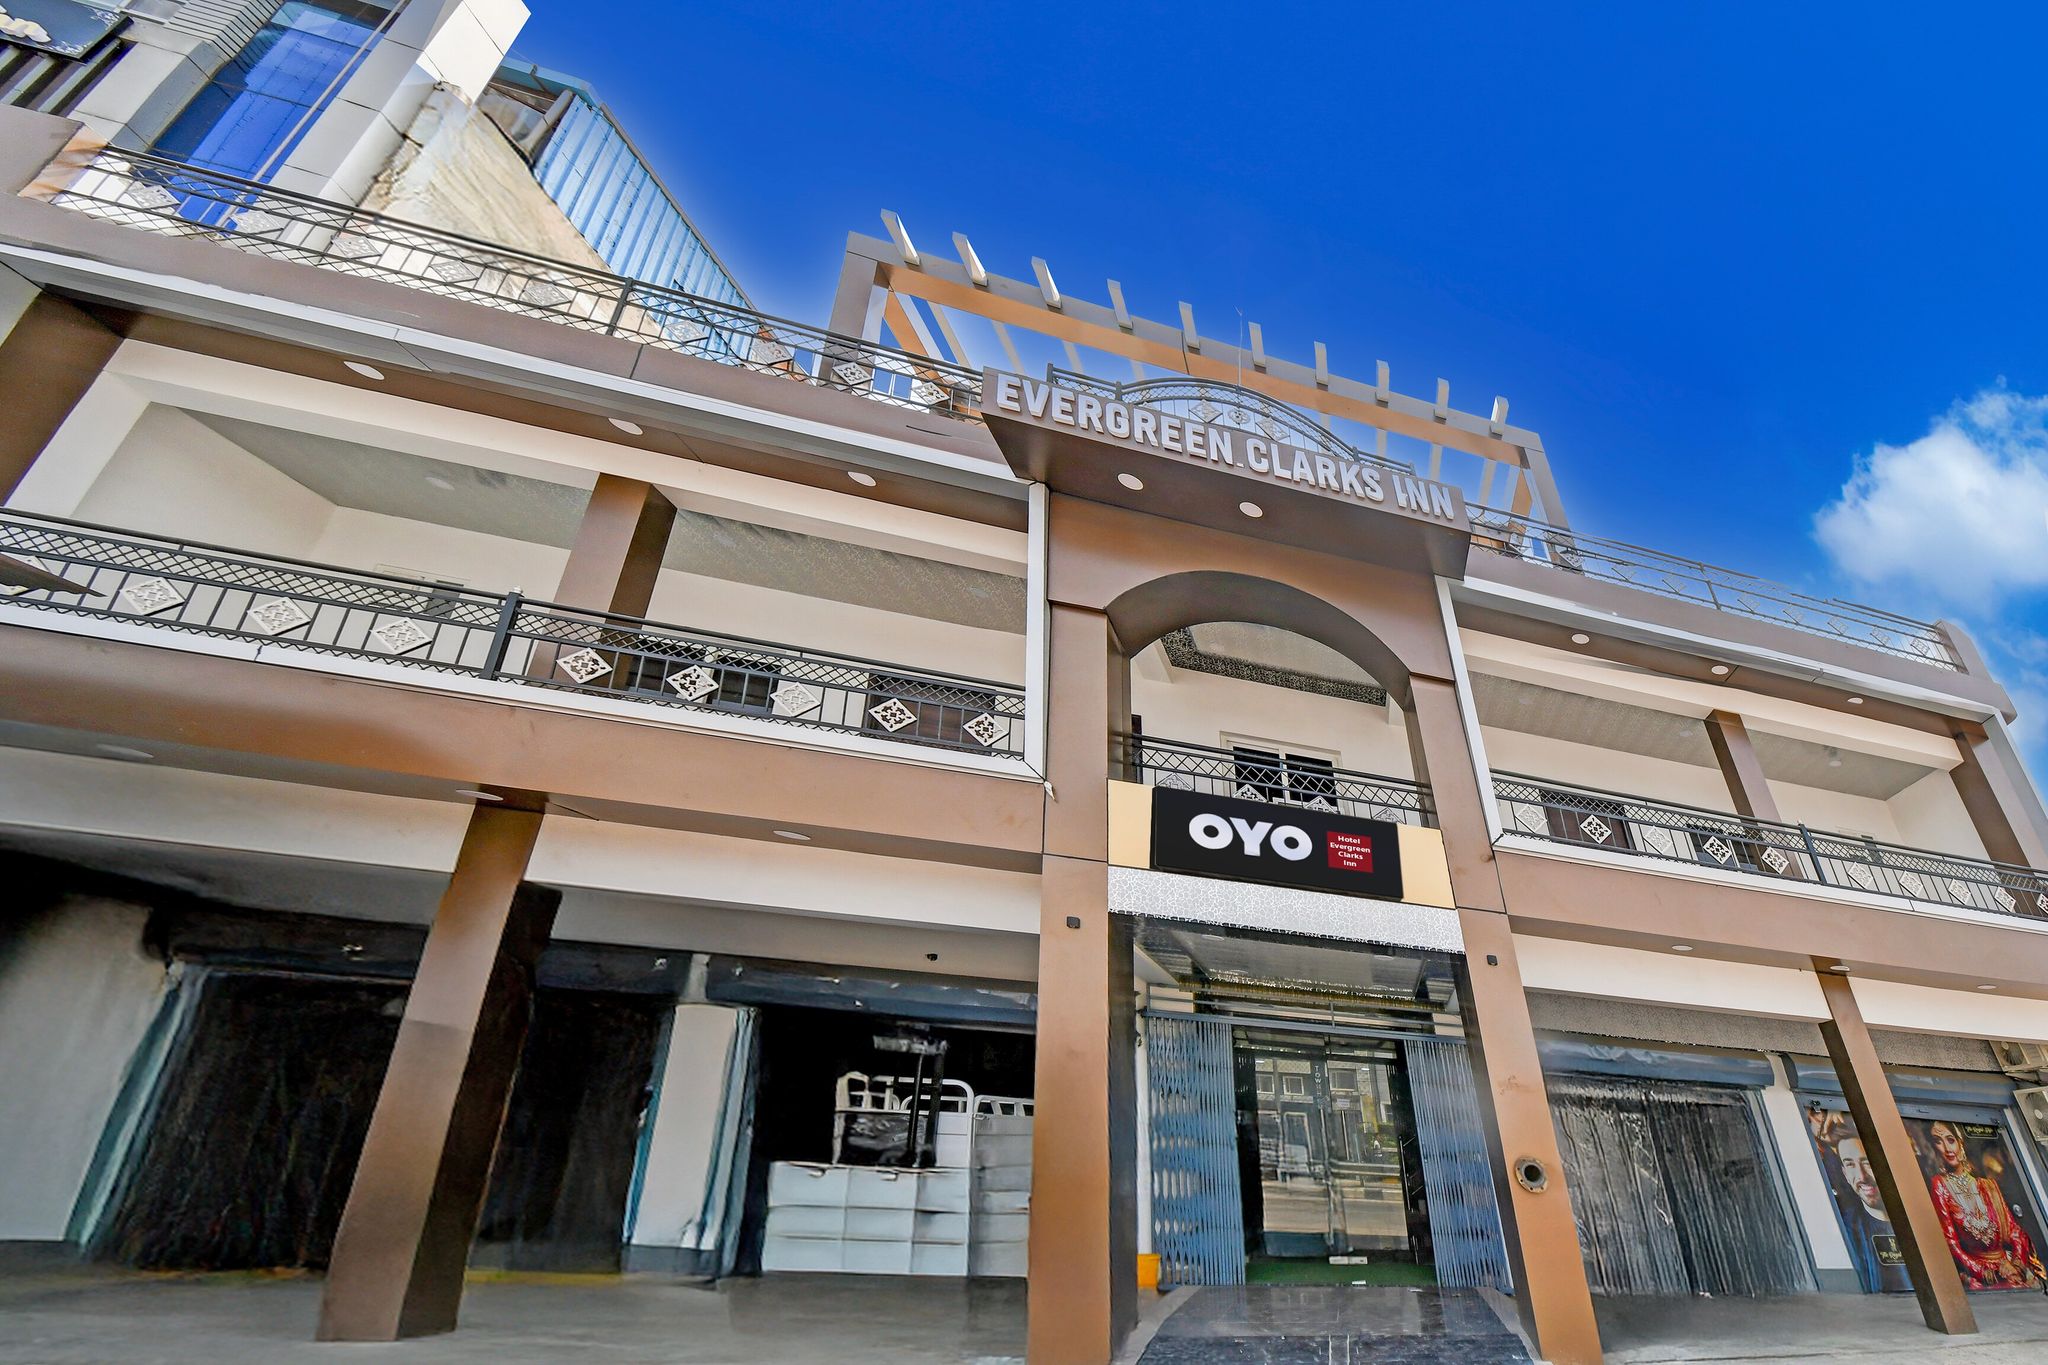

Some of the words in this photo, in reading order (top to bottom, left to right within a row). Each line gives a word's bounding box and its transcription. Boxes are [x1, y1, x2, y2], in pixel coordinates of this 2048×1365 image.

[1246, 438, 1385, 502] CLARKS
[1391, 474, 1455, 520] INN
[1188, 813, 1313, 861] OYO
[1337, 835, 1361, 844] Hotel
[1330, 842, 1371, 853] Evergreen
[1338, 850, 1364, 860] Clarks
[1343, 859, 1357, 867] Inn
